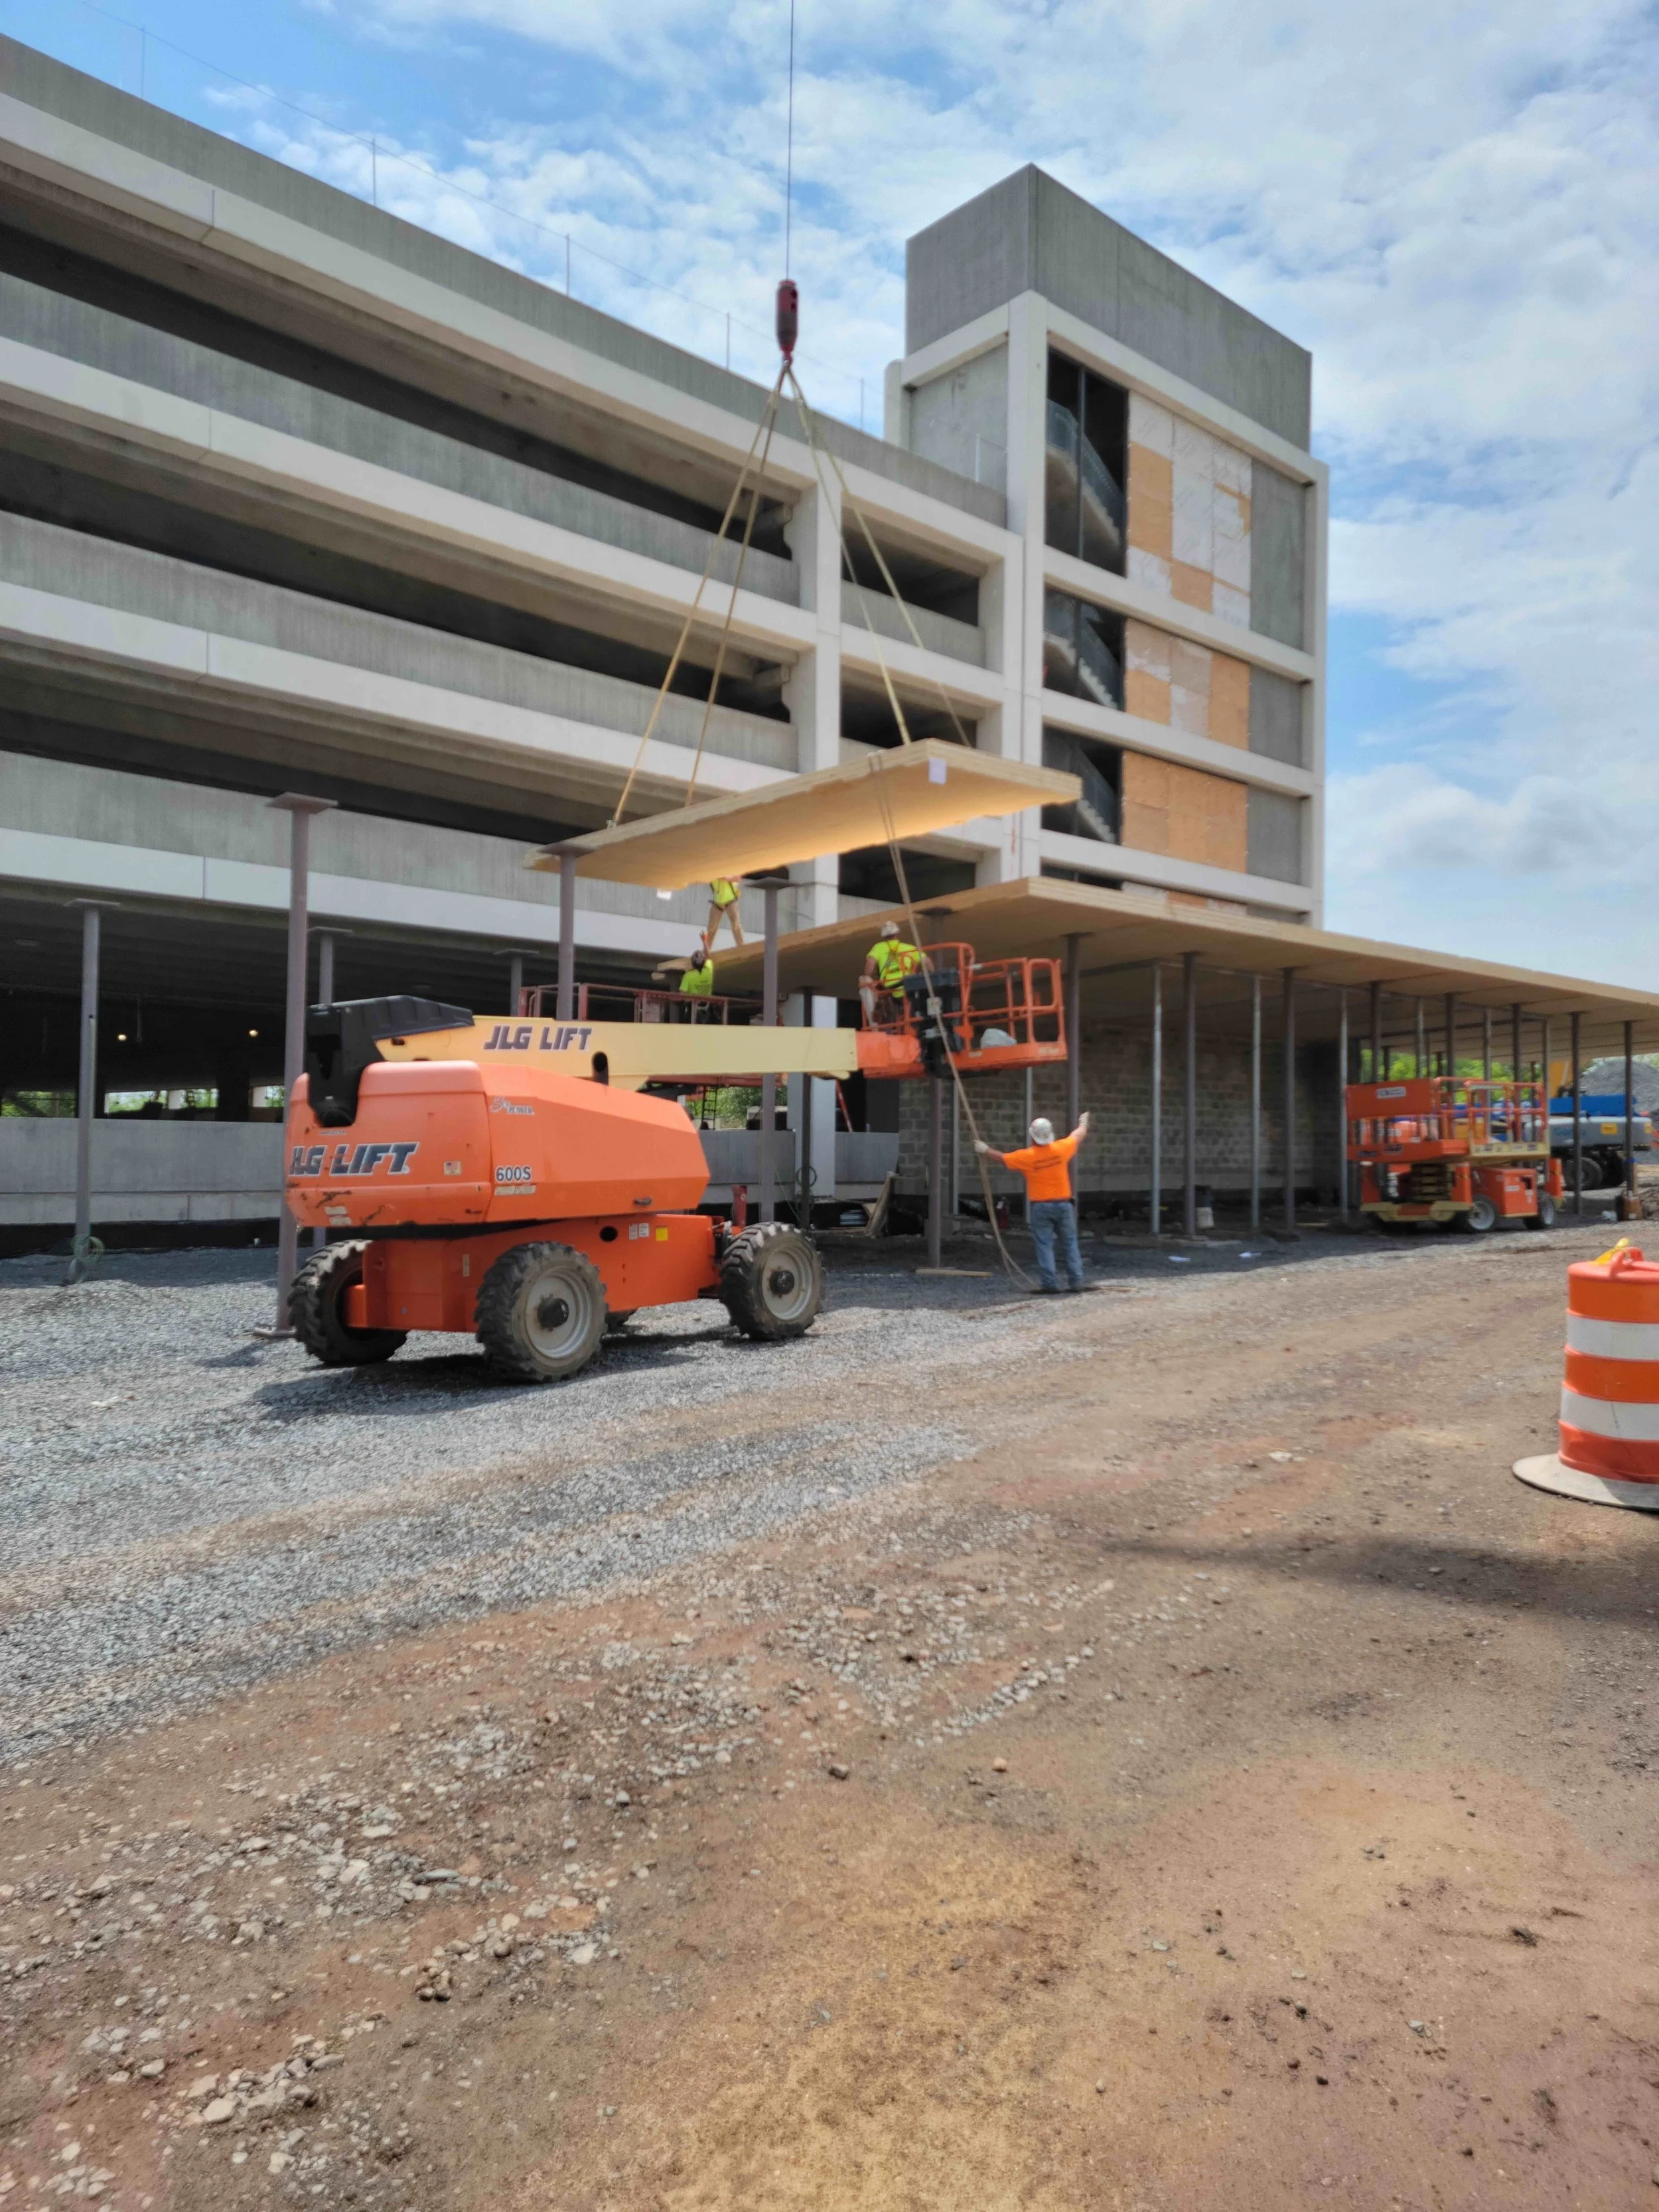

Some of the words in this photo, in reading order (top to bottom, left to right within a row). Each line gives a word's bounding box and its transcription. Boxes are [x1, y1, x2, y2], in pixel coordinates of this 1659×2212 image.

[483, 1025, 533, 1050] JLG
[539, 1026, 593, 1051] LIFT
[329, 1142, 419, 1177] LIFT
[496, 1165, 532, 1181] 600S
